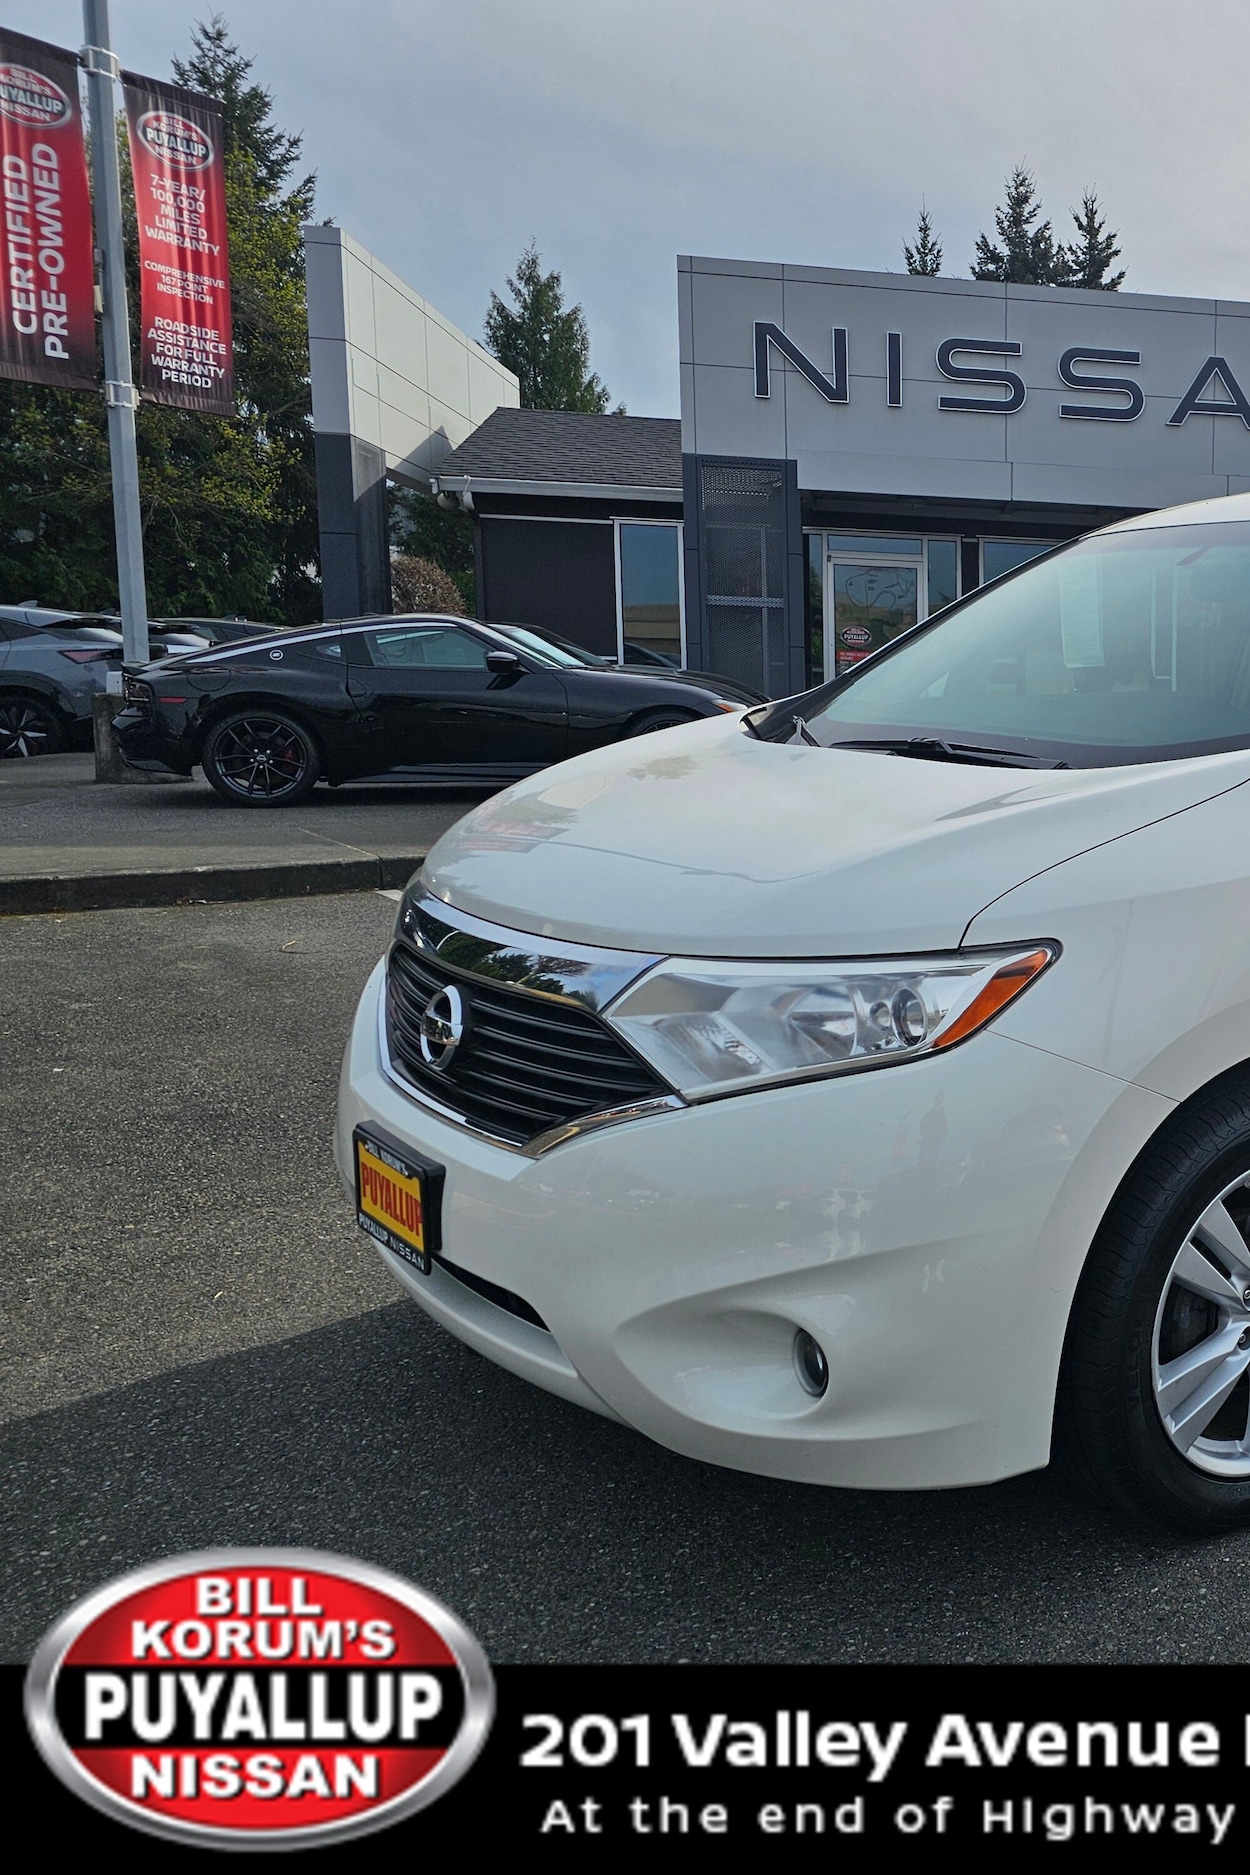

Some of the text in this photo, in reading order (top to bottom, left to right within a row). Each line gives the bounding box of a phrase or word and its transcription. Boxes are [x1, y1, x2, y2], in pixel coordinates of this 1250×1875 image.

[0, 84, 63, 114] UYALLUP
[152, 120, 198, 141] KORUM'S
[163, 116, 184, 130] BILL
[146, 127, 207, 157] PUYALLUP
[155, 145, 197, 165] NISSAN
[150, 174, 205, 199] 7-YEAR/
[160, 204, 201, 225] MILES
[154, 215, 208, 240] LIMITED
[3, 155, 38, 335] CERTIFIED
[32, 143, 69, 359] PRE-OWNED
[144, 225, 220, 256] WARRANTY
[144, 260, 225, 289] COMPREHENSIVE
[161, 274, 208, 293] 167 POINT
[157, 283, 213, 304] INSPECTION
[154, 316, 219, 341] ROADSIDE
[147, 328, 227, 355] ASSISTANCE
[151, 353, 225, 379] WARRANTY
[156, 343, 217, 366] FOR FULL
[162, 369, 212, 389] PERIOD
[361, 1161, 423, 1237] PUYALLUP
[358, 1212, 425, 1271] PUYALLUP NISSAN
